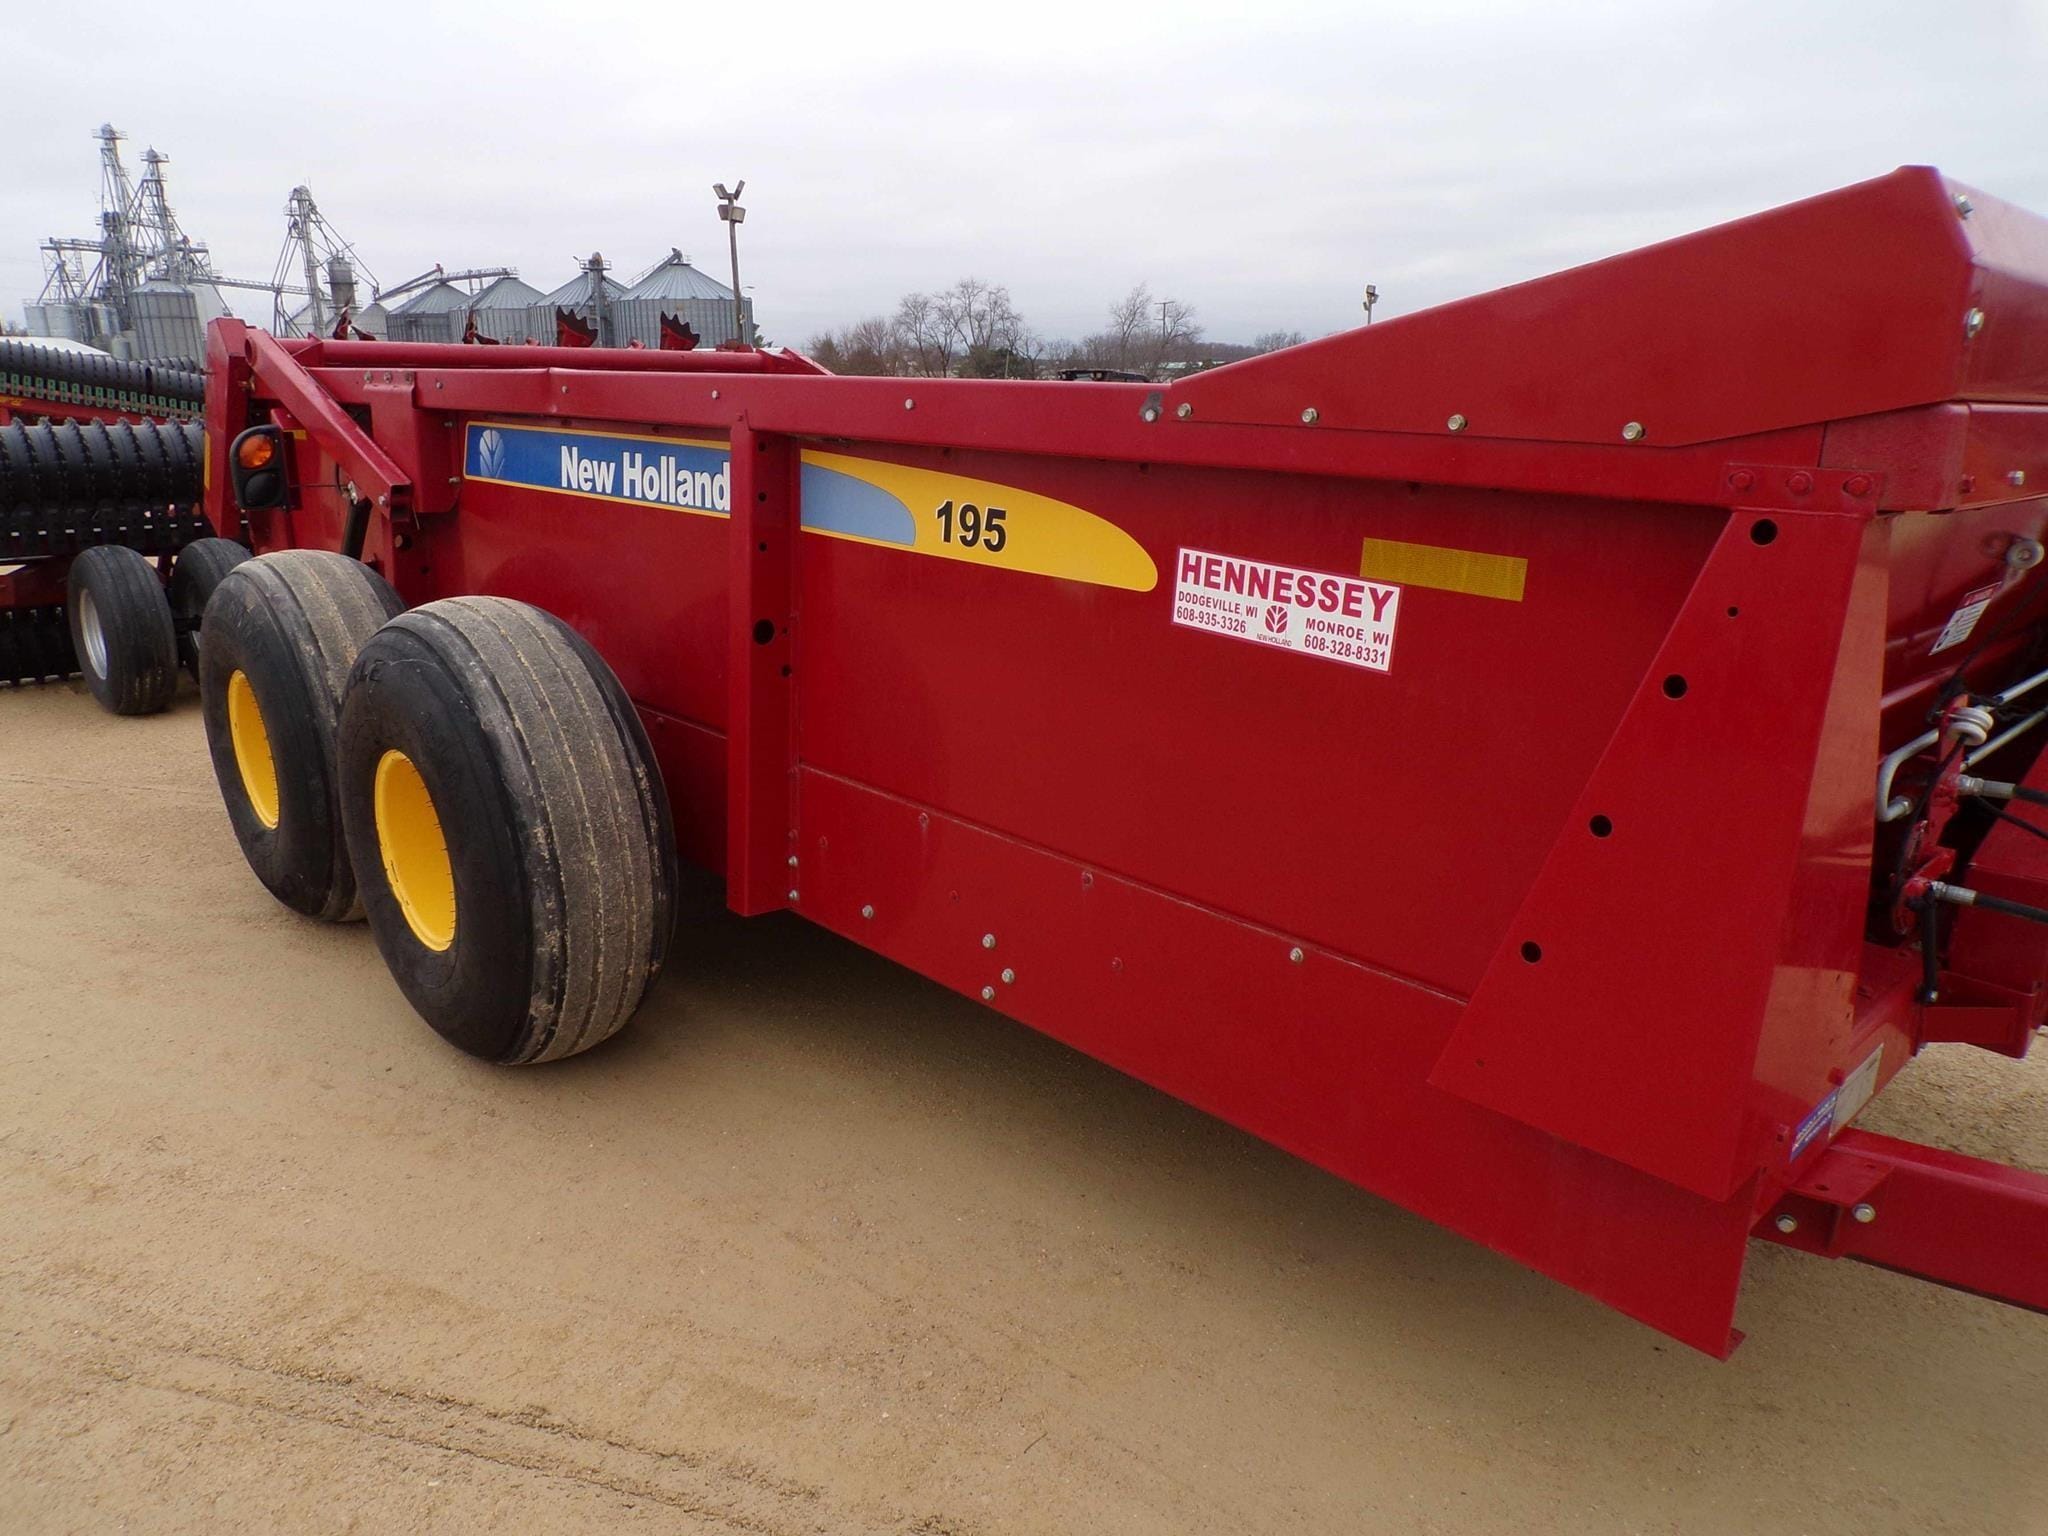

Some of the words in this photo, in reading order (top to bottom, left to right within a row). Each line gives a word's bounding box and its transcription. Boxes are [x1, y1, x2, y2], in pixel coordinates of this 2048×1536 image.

[560, 445, 616, 494] New
[623, 451, 731, 511] Holland
[936, 500, 1007, 552] 195
[1180, 552, 1395, 623] HENNESSEY
[1176, 606, 1247, 634] 608-935-3326
[1178, 590, 1244, 616] DODGEVILLE,
[1245, 605, 1259, 619] WI
[1305, 618, 1368, 643] MONROE,
[1372, 631, 1390, 647] WI
[1304, 634, 1387, 665] 608-328-8331
